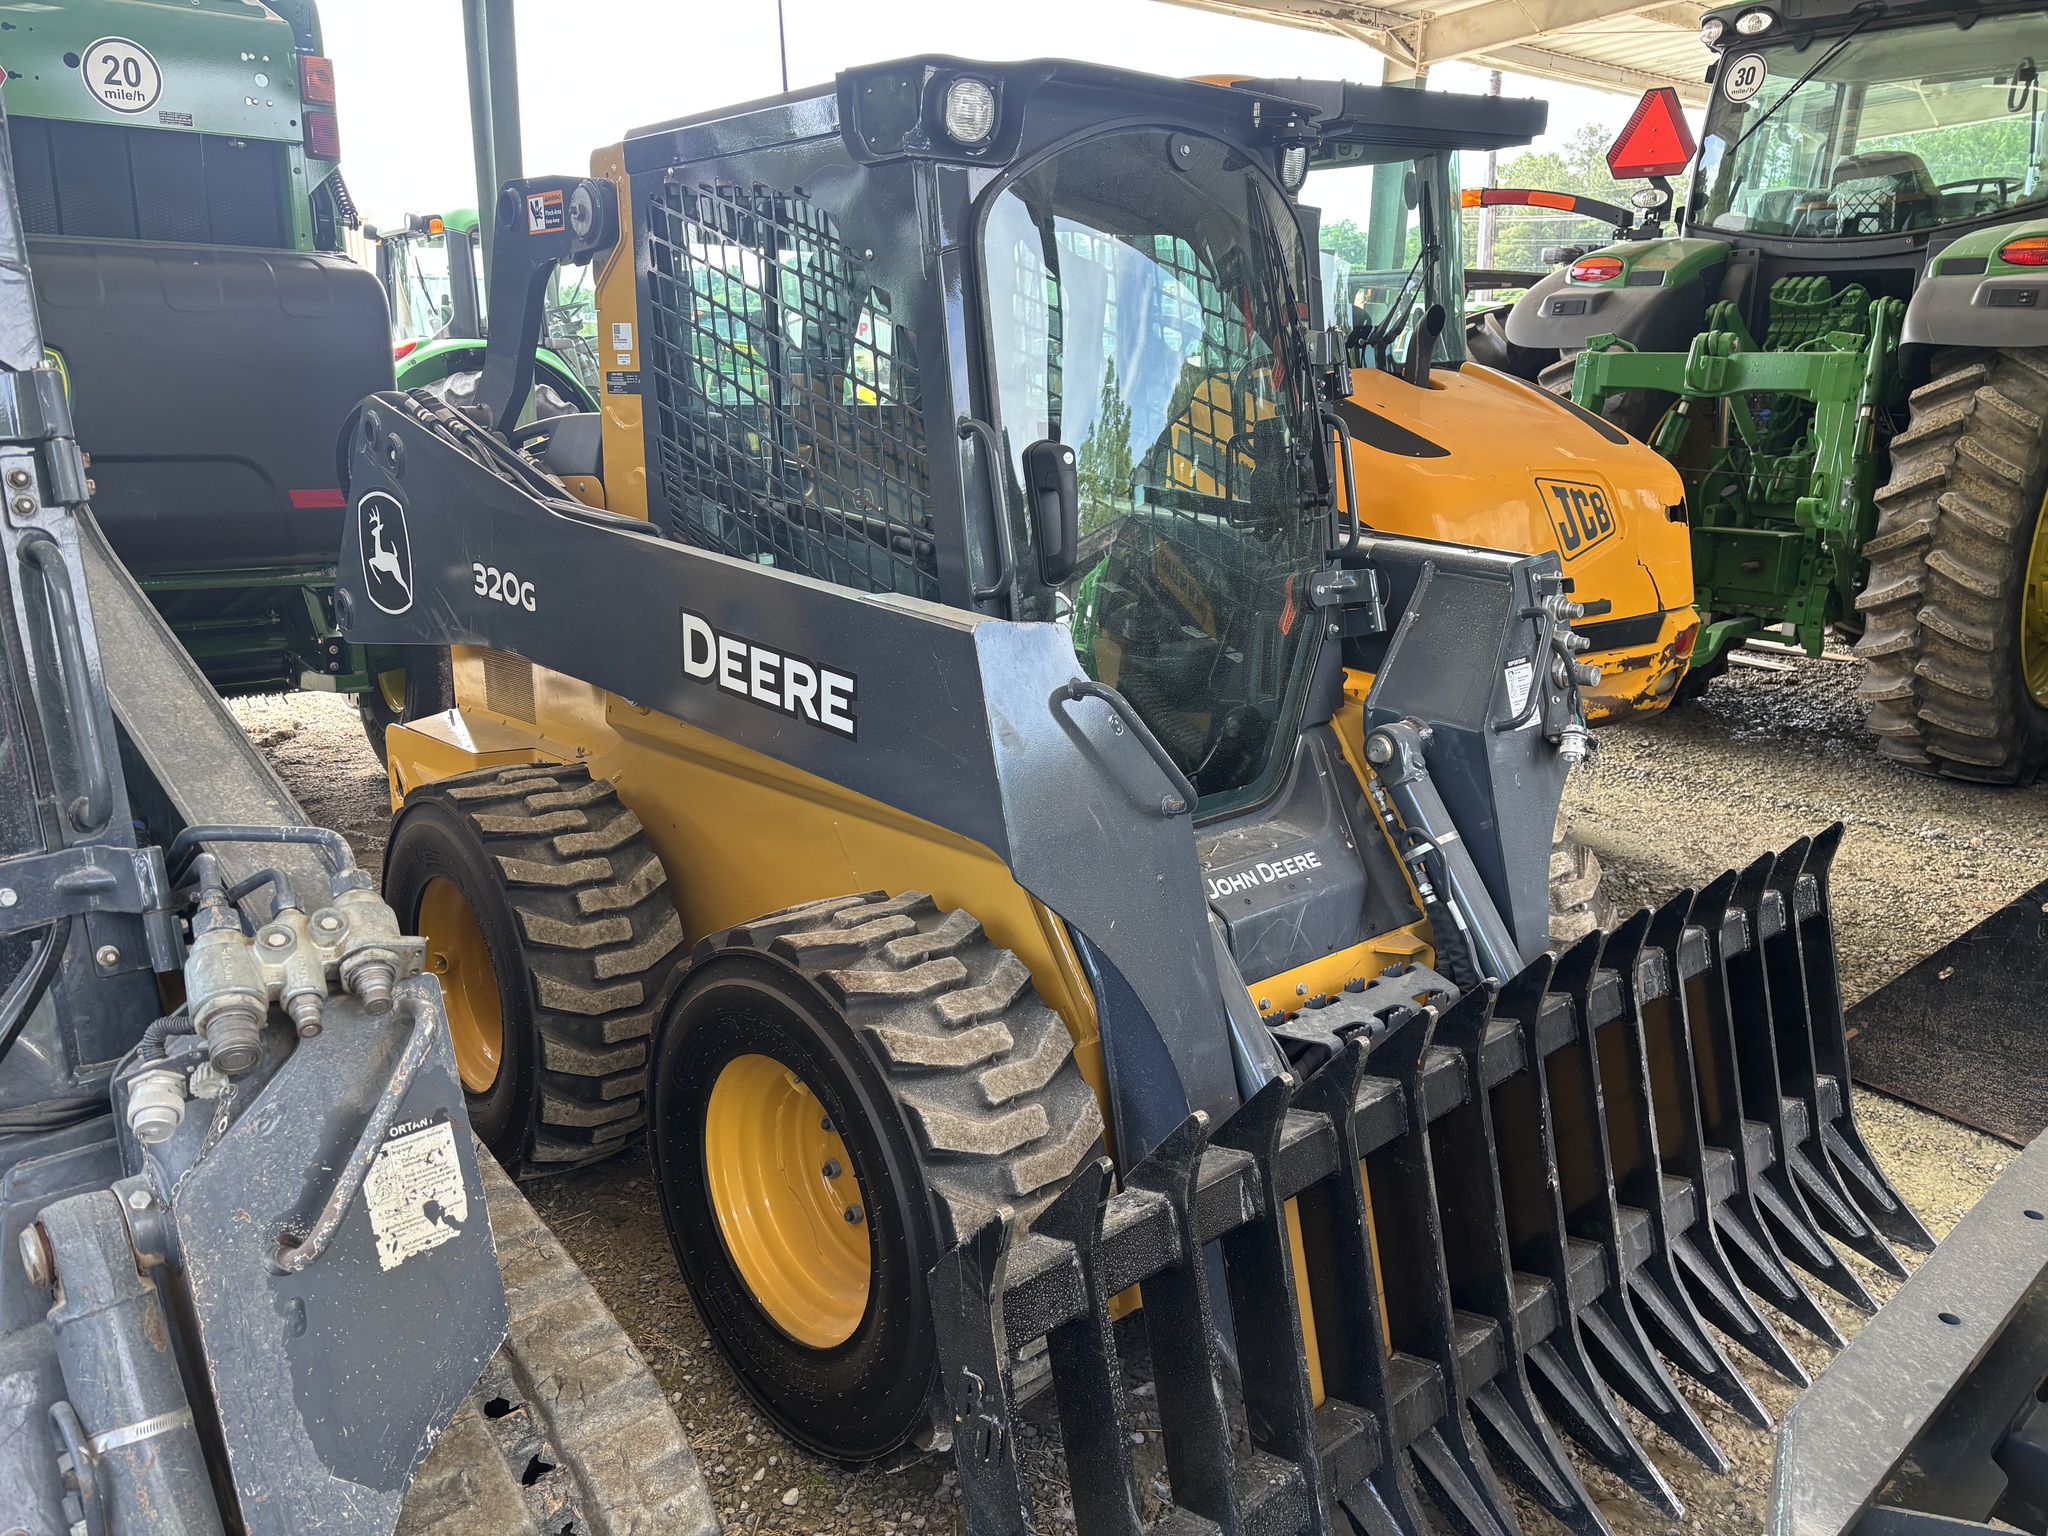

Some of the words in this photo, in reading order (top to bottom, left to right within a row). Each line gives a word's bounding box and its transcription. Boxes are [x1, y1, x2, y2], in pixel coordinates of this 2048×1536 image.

[102, 55, 141, 88] 20
[1735, 66, 1756, 87] 30
[104, 88, 146, 102] mile/h
[1551, 485, 1611, 551] JCB
[472, 562, 536, 612] 320G
[682, 612, 854, 734] DEERE
[1207, 870, 1260, 900] JOHN
[1254, 851, 1322, 883] DEERE
[390, 1118, 433, 1136] ORTAN
